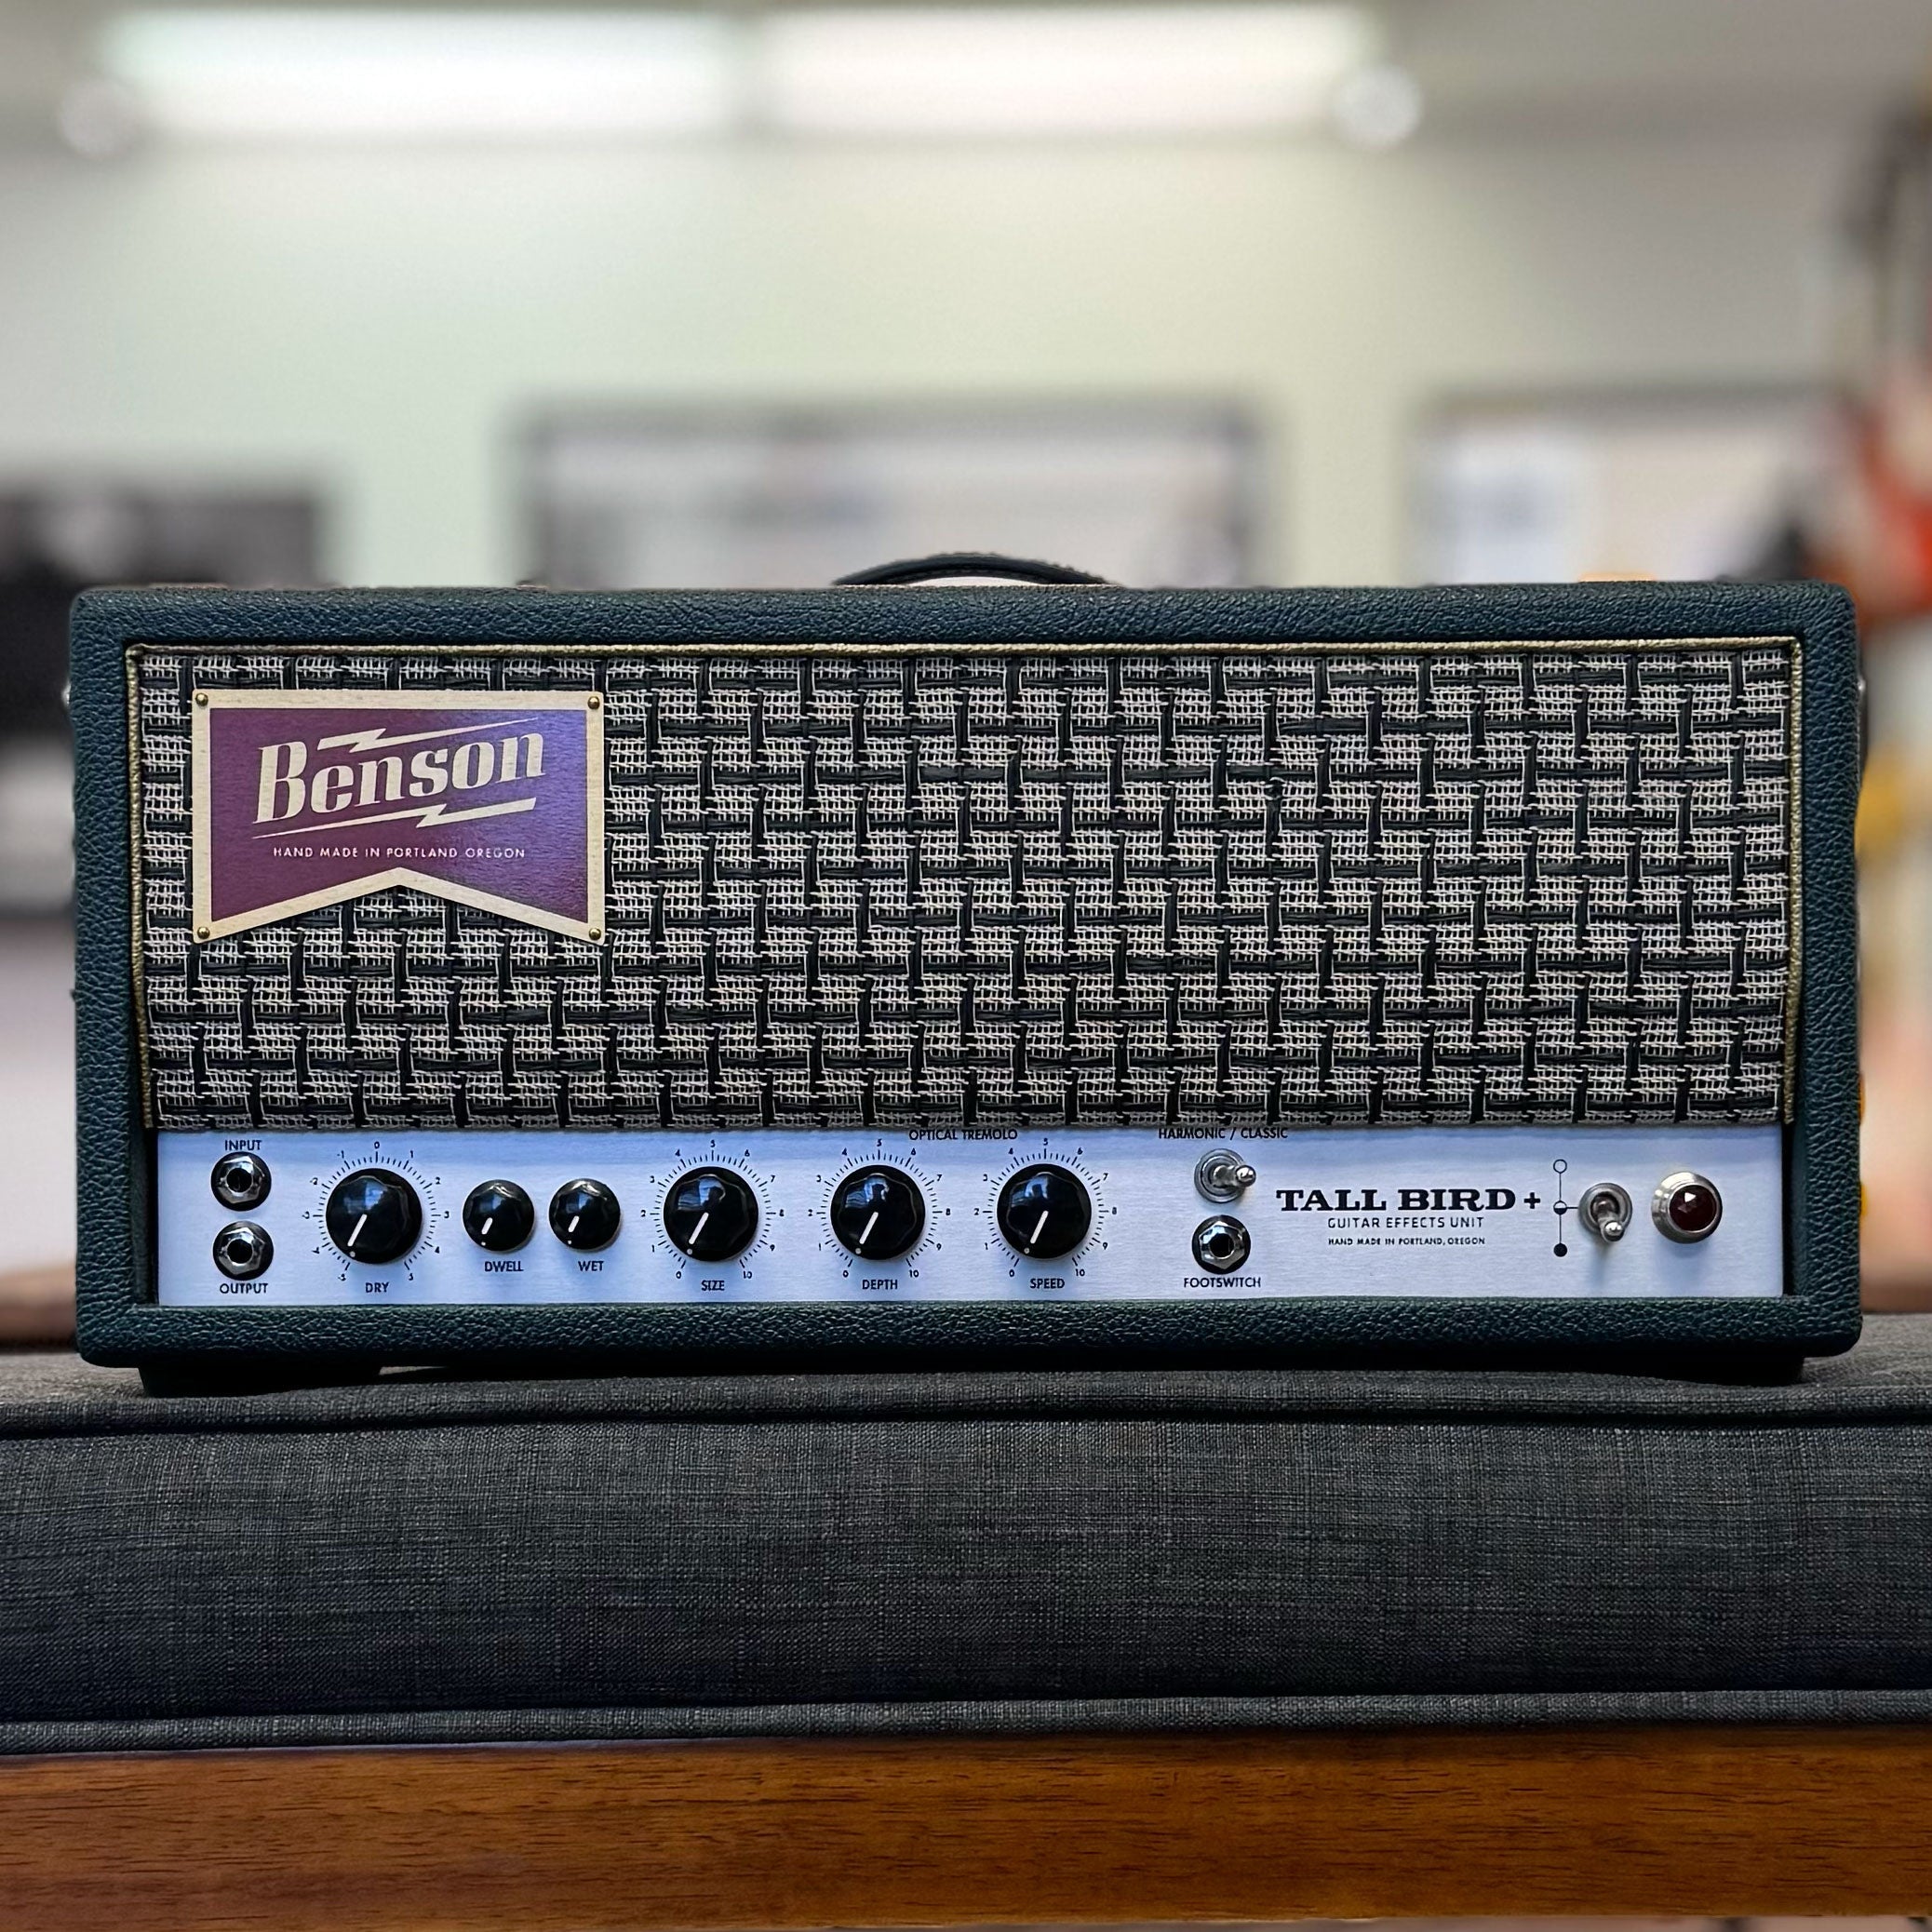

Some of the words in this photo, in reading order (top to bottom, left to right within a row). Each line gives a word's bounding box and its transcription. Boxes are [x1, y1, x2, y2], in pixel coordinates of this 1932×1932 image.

[251, 731, 547, 825] Benson
[273, 847, 314, 858] HAND
[320, 847, 357, 858] MADE
[365, 847, 381, 858] IN
[386, 847, 458, 858] PORTLAND
[464, 847, 525, 858] OREGON
[909, 1129, 958, 1141] OPTICAL
[961, 1129, 1018, 1140] TREMOLO
[1159, 1128, 1226, 1140] HARMONIC
[1241, 1128, 1289, 1139] CLASSIC
[224, 1140, 262, 1151] INPUT
[1276, 1189, 1387, 1212] TALL
[1398, 1188, 1516, 1212] BIRD
[1328, 1217, 1380, 1228] GUITAR
[1386, 1217, 1444, 1228] EFFECTS
[1450, 1216, 1484, 1228] UNIT
[1399, 1238, 1445, 1246] PORTLAND,
[484, 1261, 524, 1272] DWELL
[578, 1260, 604, 1271] WET
[366, 1282, 389, 1293] DRY
[701, 1280, 725, 1291] SIZE
[862, 1279, 898, 1290] DEPTH
[1030, 1279, 1065, 1289] SPEED
[1184, 1277, 1261, 1288] FOOTSWITCH
[220, 1283, 268, 1294] OUTPUT
